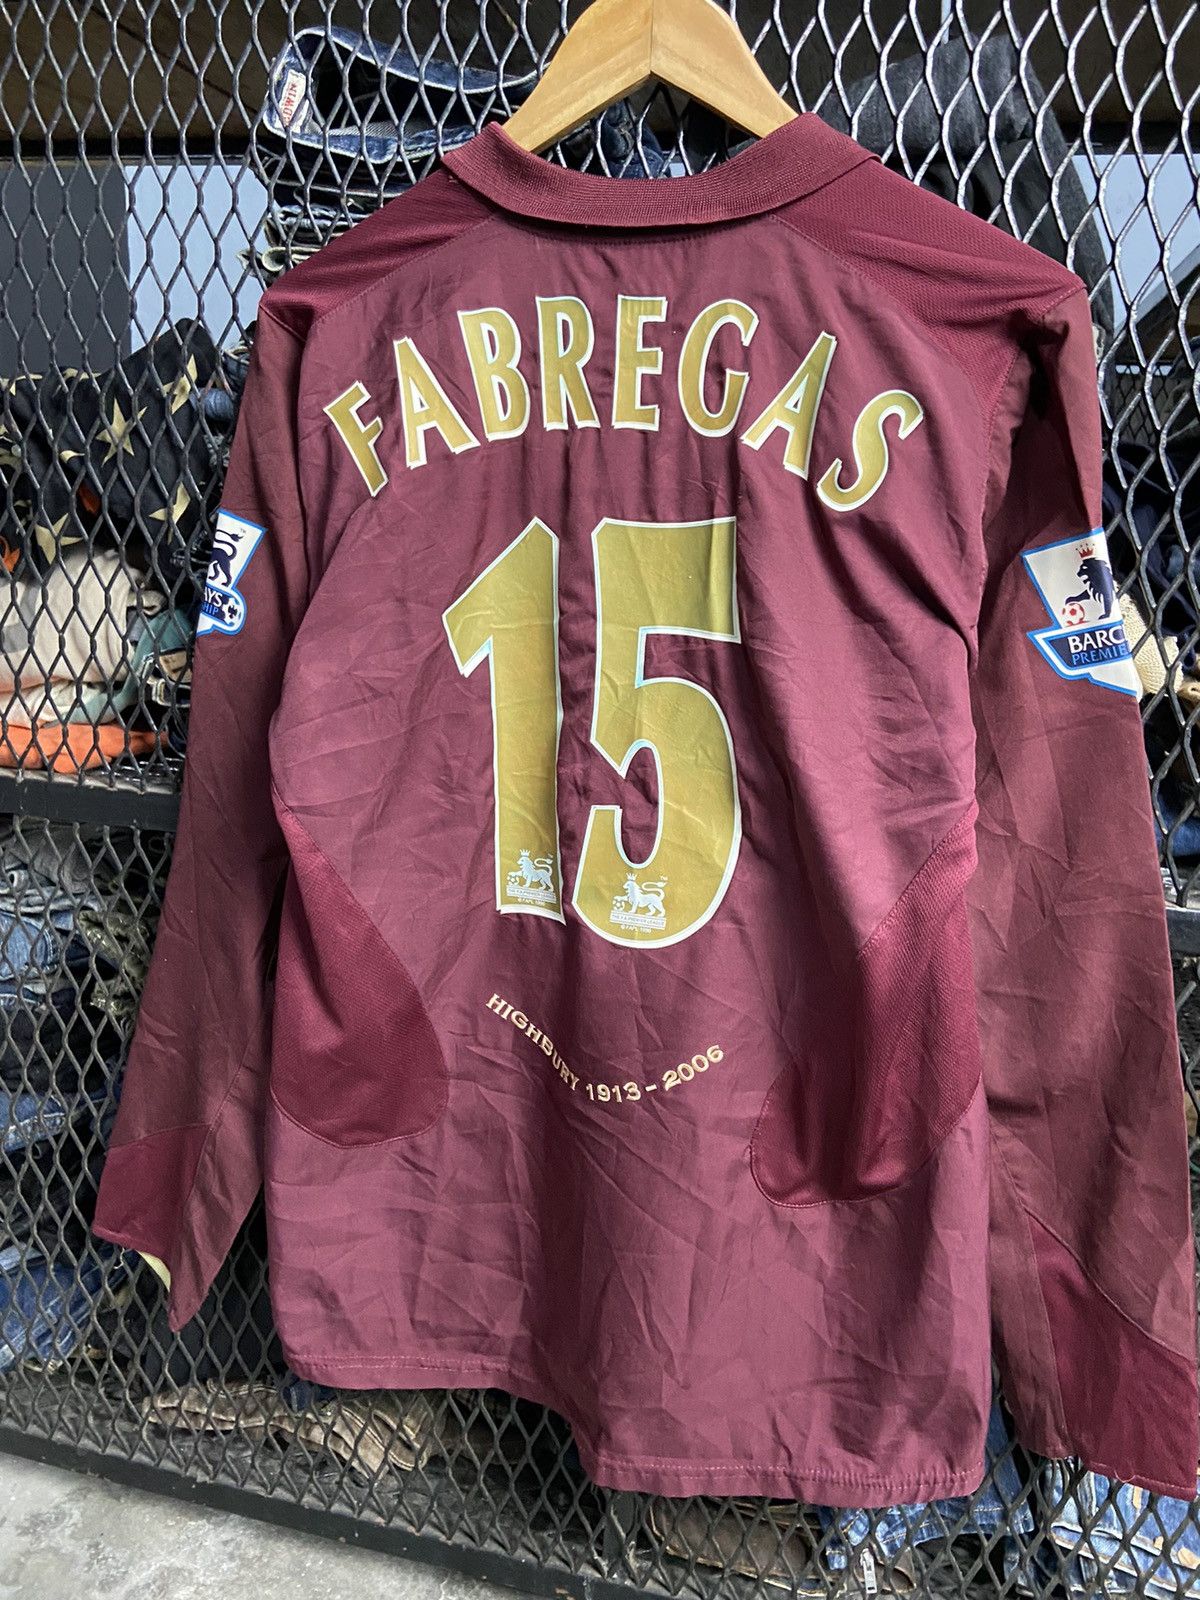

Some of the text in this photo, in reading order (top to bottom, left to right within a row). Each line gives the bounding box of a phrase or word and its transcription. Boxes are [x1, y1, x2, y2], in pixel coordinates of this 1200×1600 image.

[323, 295, 924, 512] FABREGAS
[1068, 625, 1126, 653] BARC
[442, 516, 742, 949] 15
[485, 993, 580, 1091] HIGHBURY
[586, 1081, 641, 1103] 1913
[662, 1045, 724, 1091] 2006
